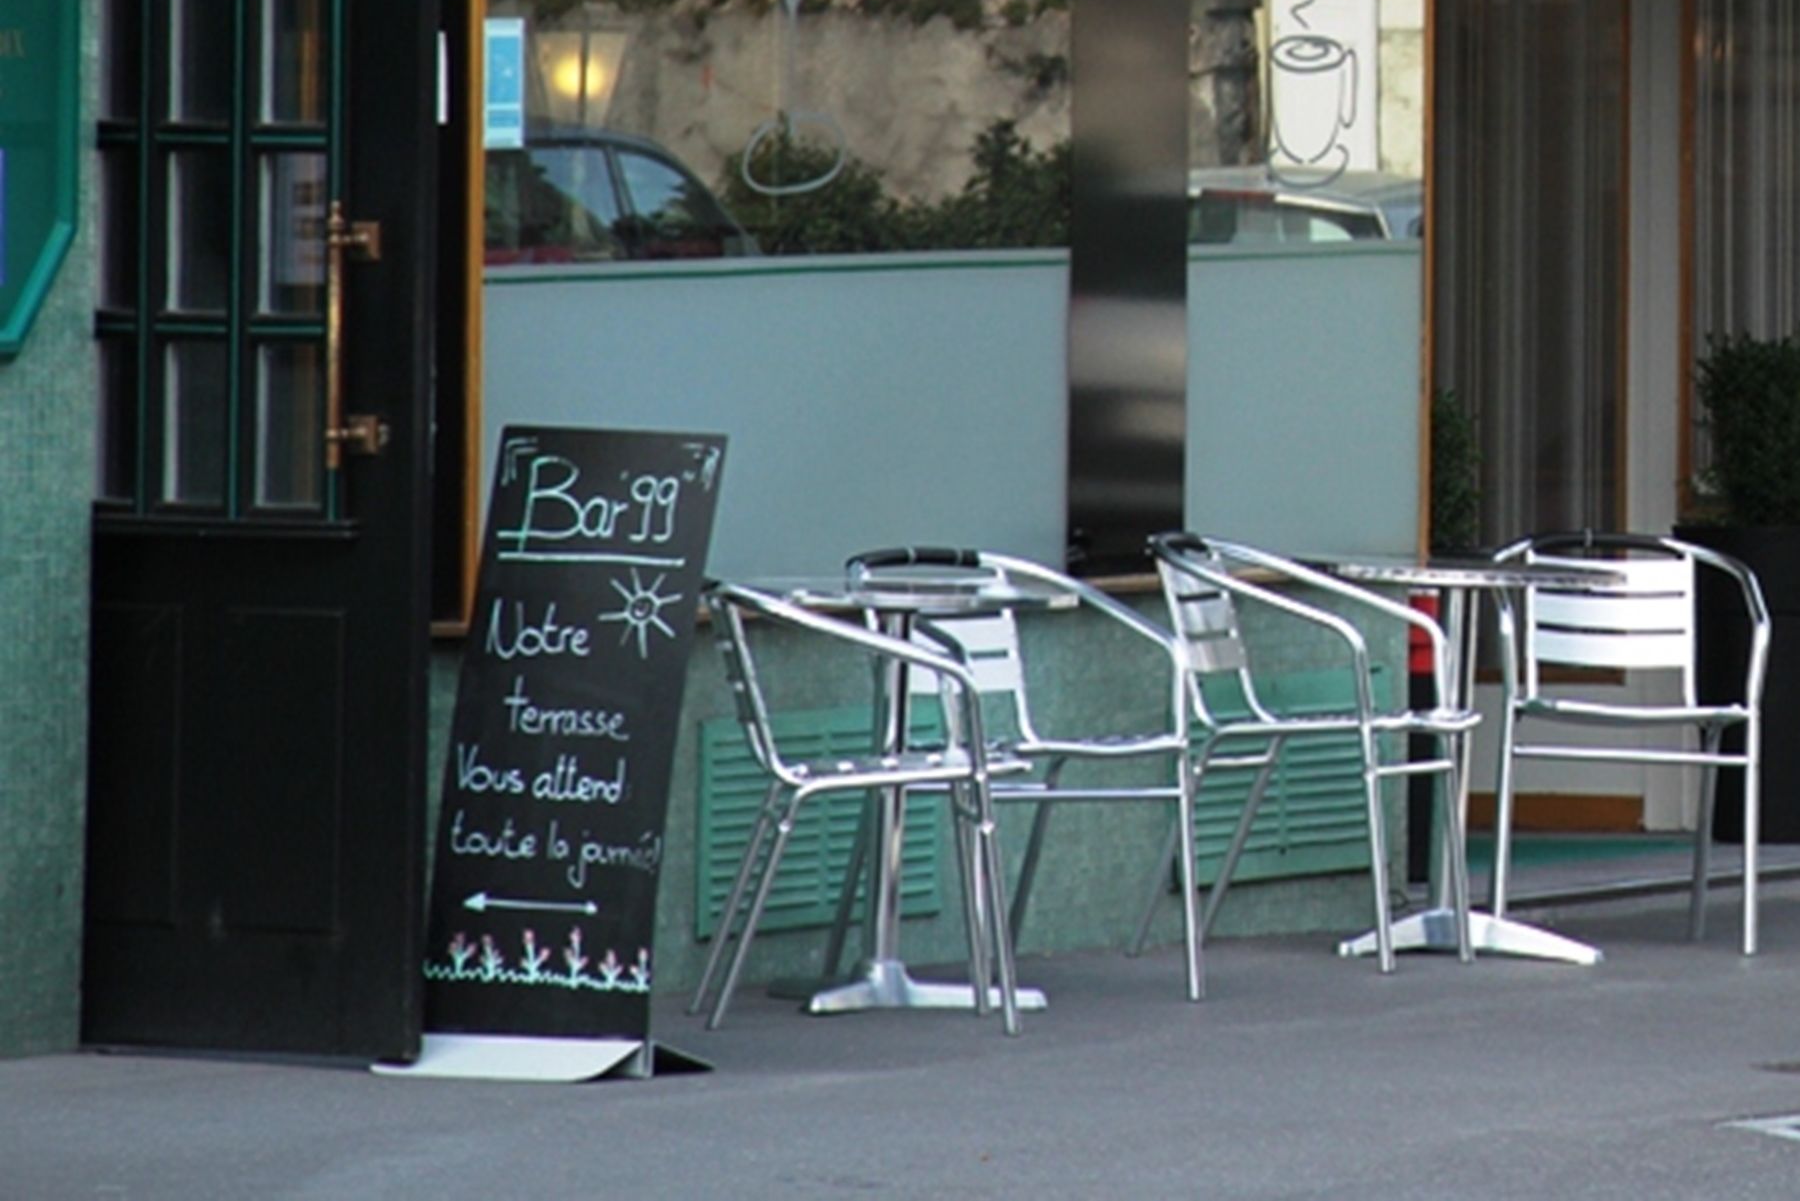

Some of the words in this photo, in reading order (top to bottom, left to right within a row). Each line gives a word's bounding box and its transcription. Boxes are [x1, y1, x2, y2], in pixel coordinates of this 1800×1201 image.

[497, 456, 629, 554] Bar
[485, 598, 591, 660] Notre
[503, 675, 630, 742] terrasse
[456, 742, 526, 794] Vous
[531, 753, 627, 805] attend
[451, 809, 538, 859] toute
[547, 819, 570, 860] la
